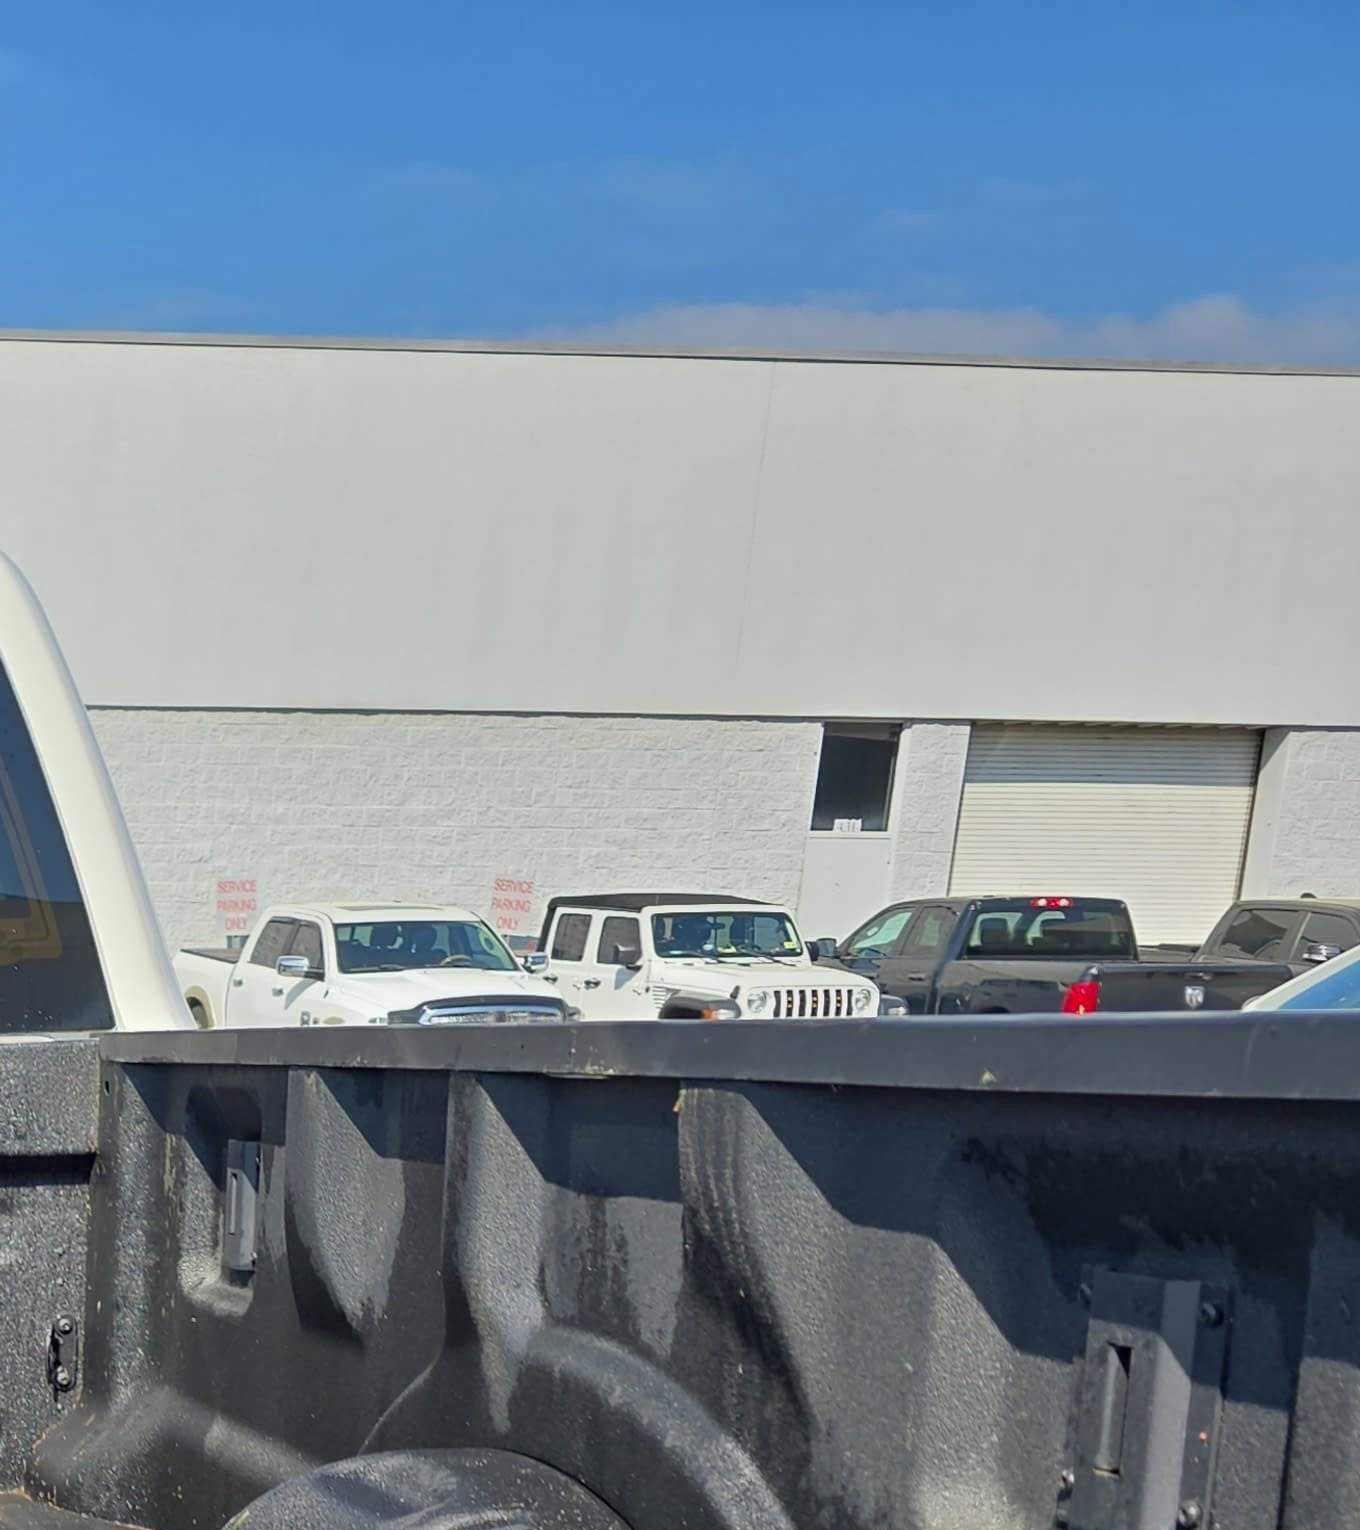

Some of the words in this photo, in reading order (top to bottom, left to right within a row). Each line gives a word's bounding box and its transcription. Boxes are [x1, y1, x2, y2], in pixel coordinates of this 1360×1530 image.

[216, 879, 257, 894] SERVICE
[494, 878, 534, 894] SERVICE
[216, 899, 257, 912] PARKING
[491, 896, 531, 913] PARKING
